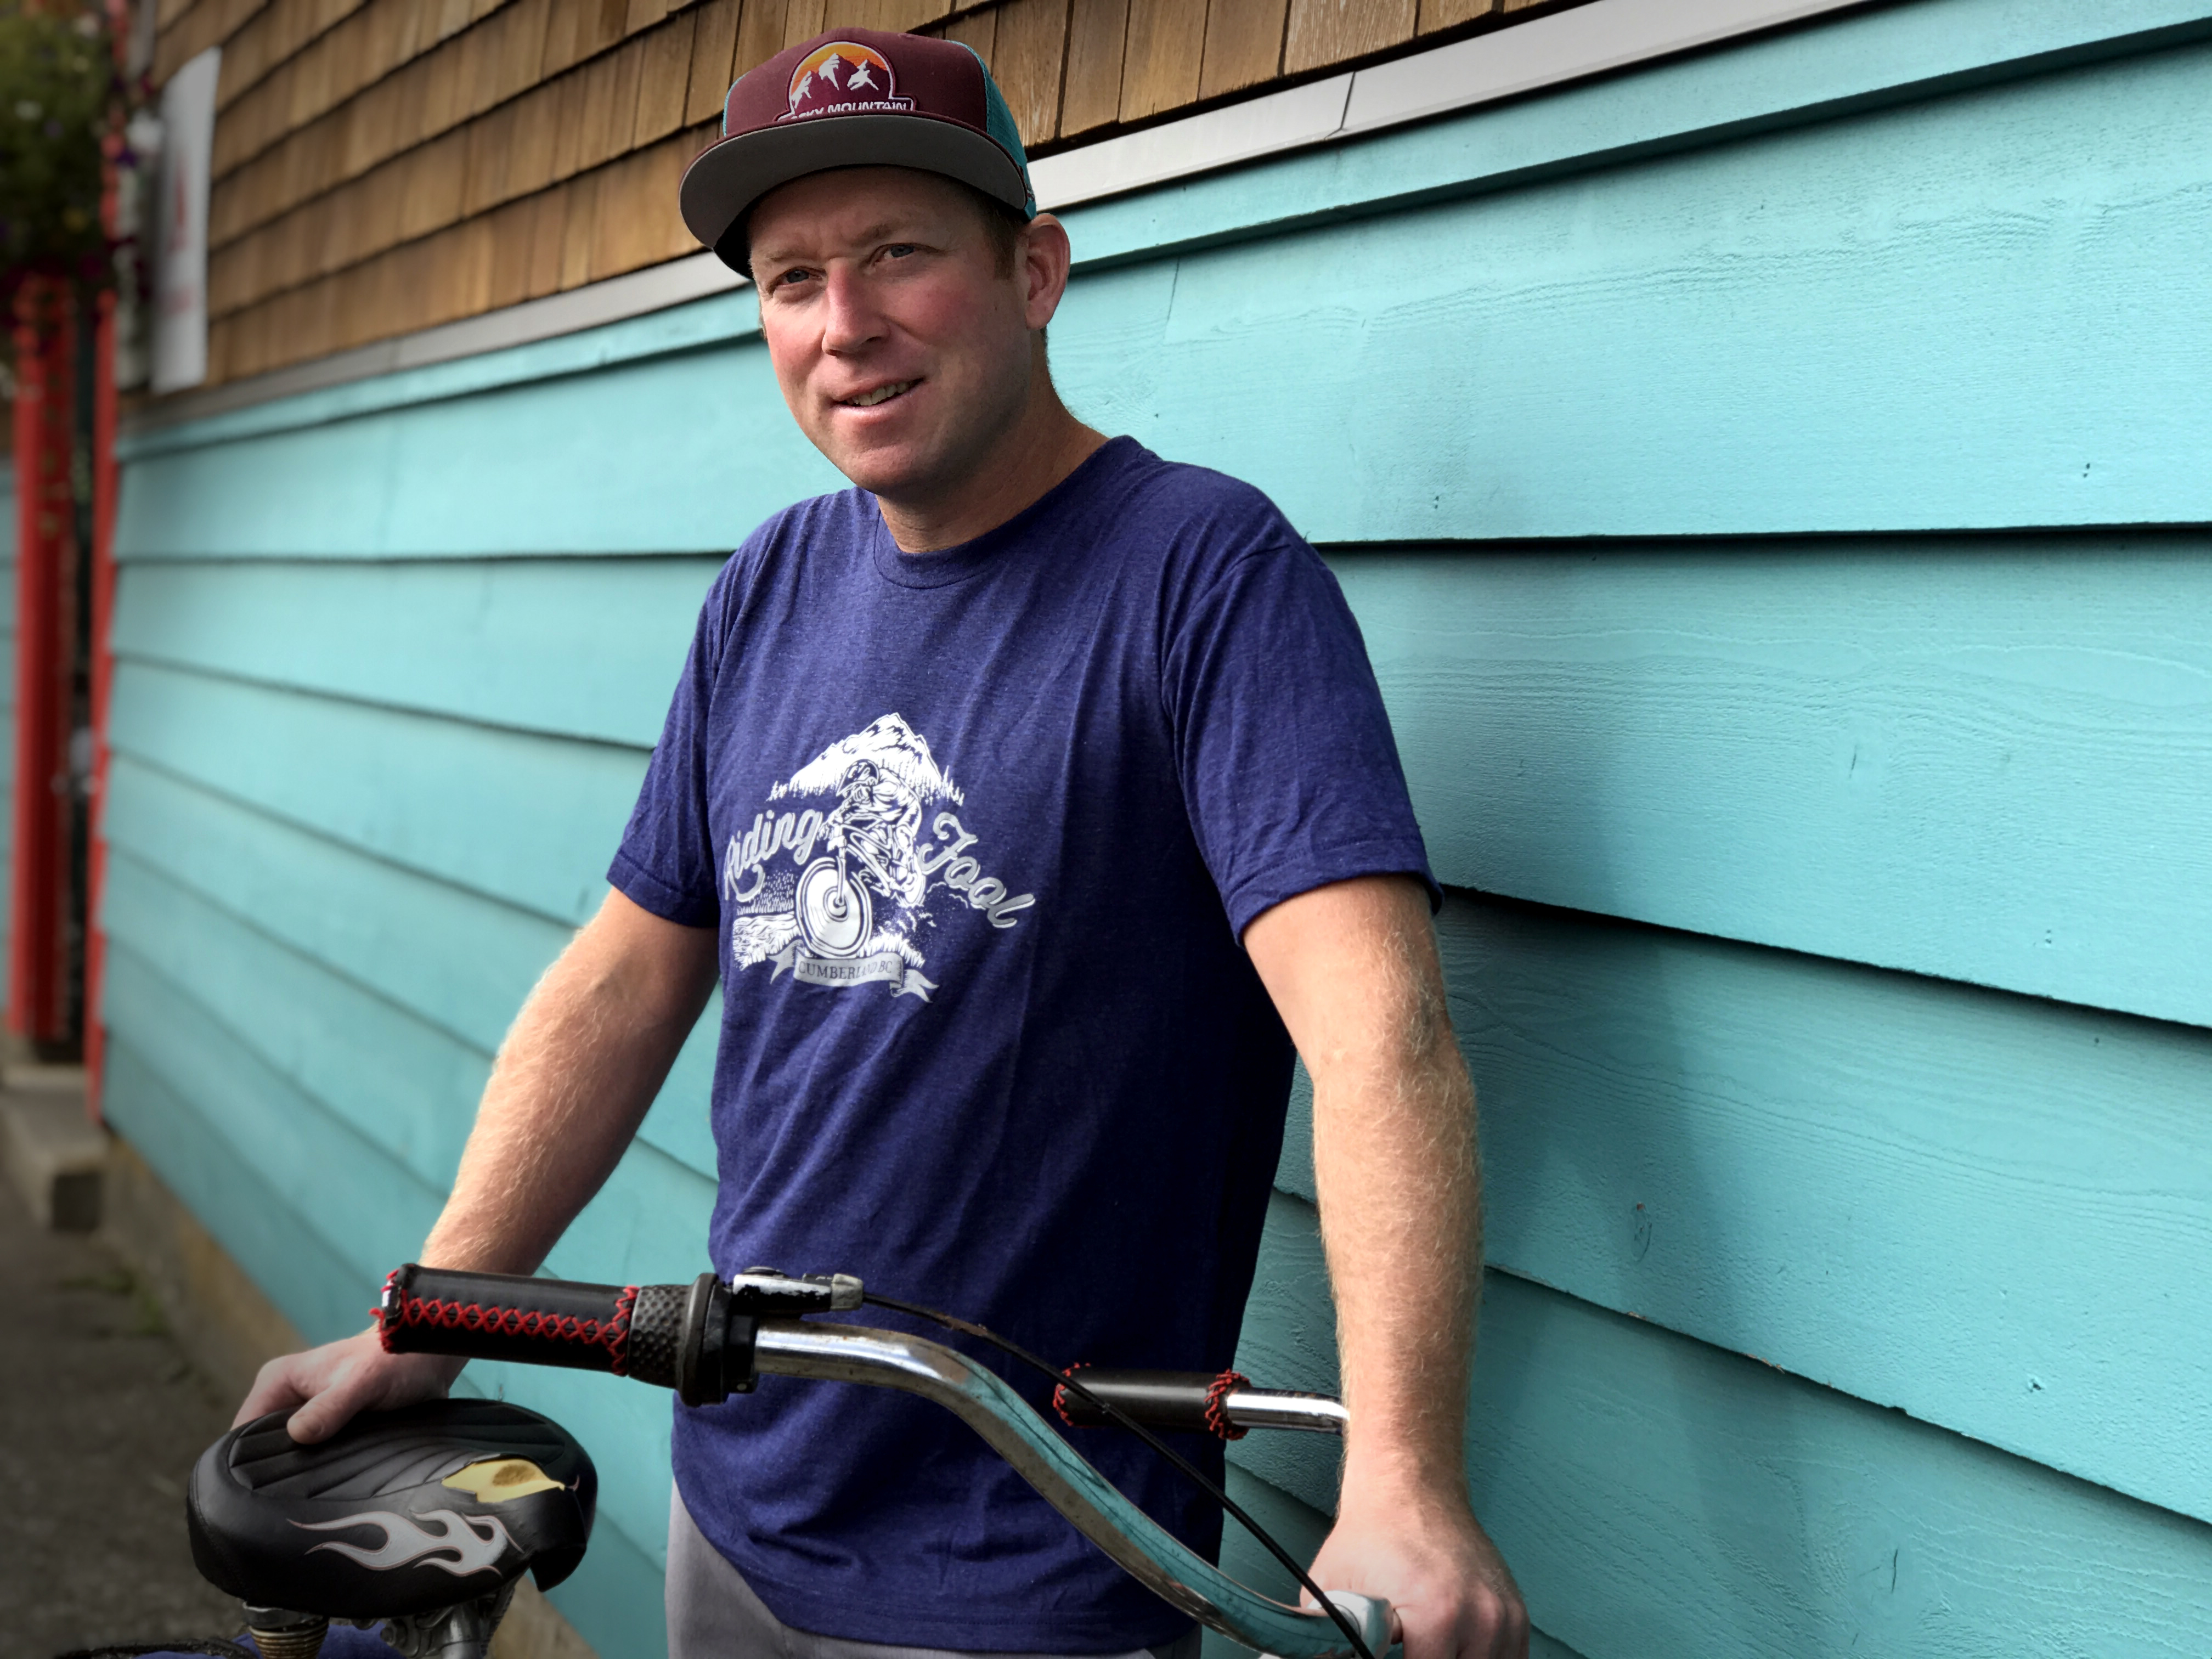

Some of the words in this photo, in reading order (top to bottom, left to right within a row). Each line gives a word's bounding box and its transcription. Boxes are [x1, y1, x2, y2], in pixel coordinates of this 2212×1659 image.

[827, 101, 907, 114] MOUNTAIN
[724, 809, 823, 902] Riding
[917, 812, 1036, 929] Fool
[798, 961, 878, 980] CUMBERLAND
[878, 960, 893, 974] BC
